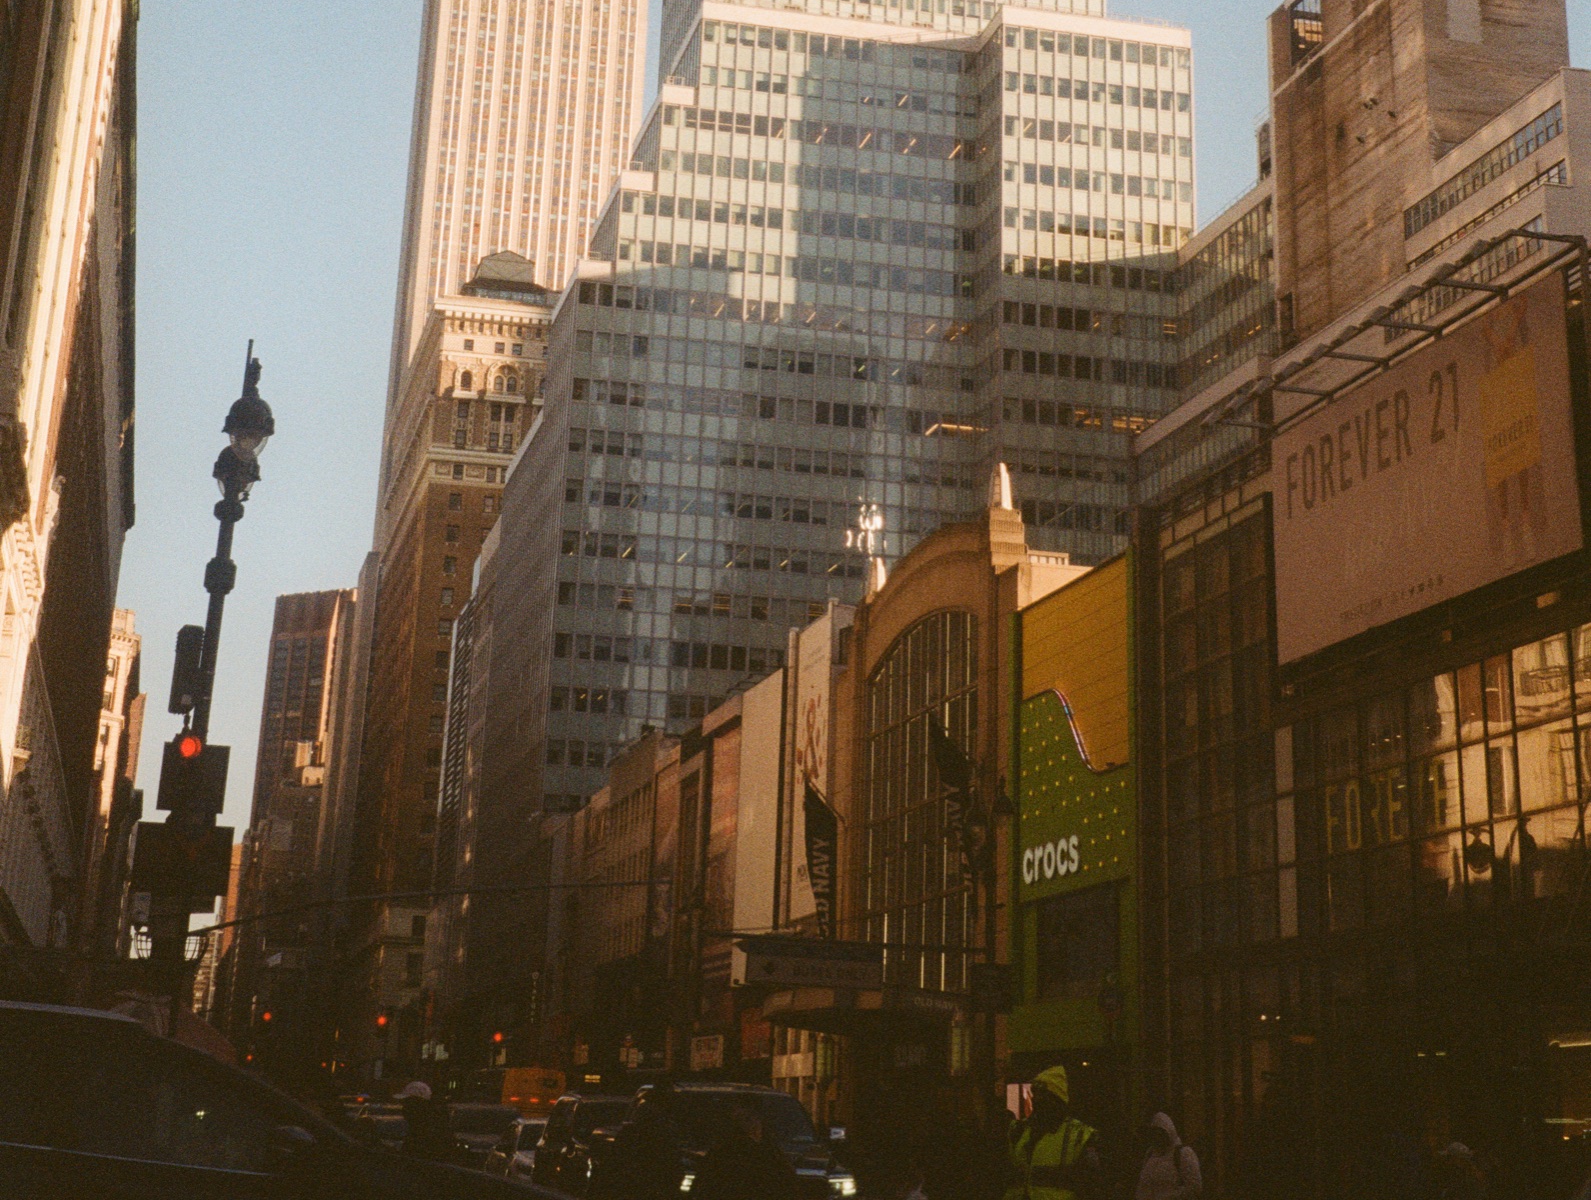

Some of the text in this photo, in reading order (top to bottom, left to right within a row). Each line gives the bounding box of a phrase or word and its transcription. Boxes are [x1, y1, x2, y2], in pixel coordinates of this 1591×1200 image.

[1286, 361, 1460, 520] FOREVER 21
[812, 836, 831, 893] NAVY
[1023, 834, 1079, 885] crocs
